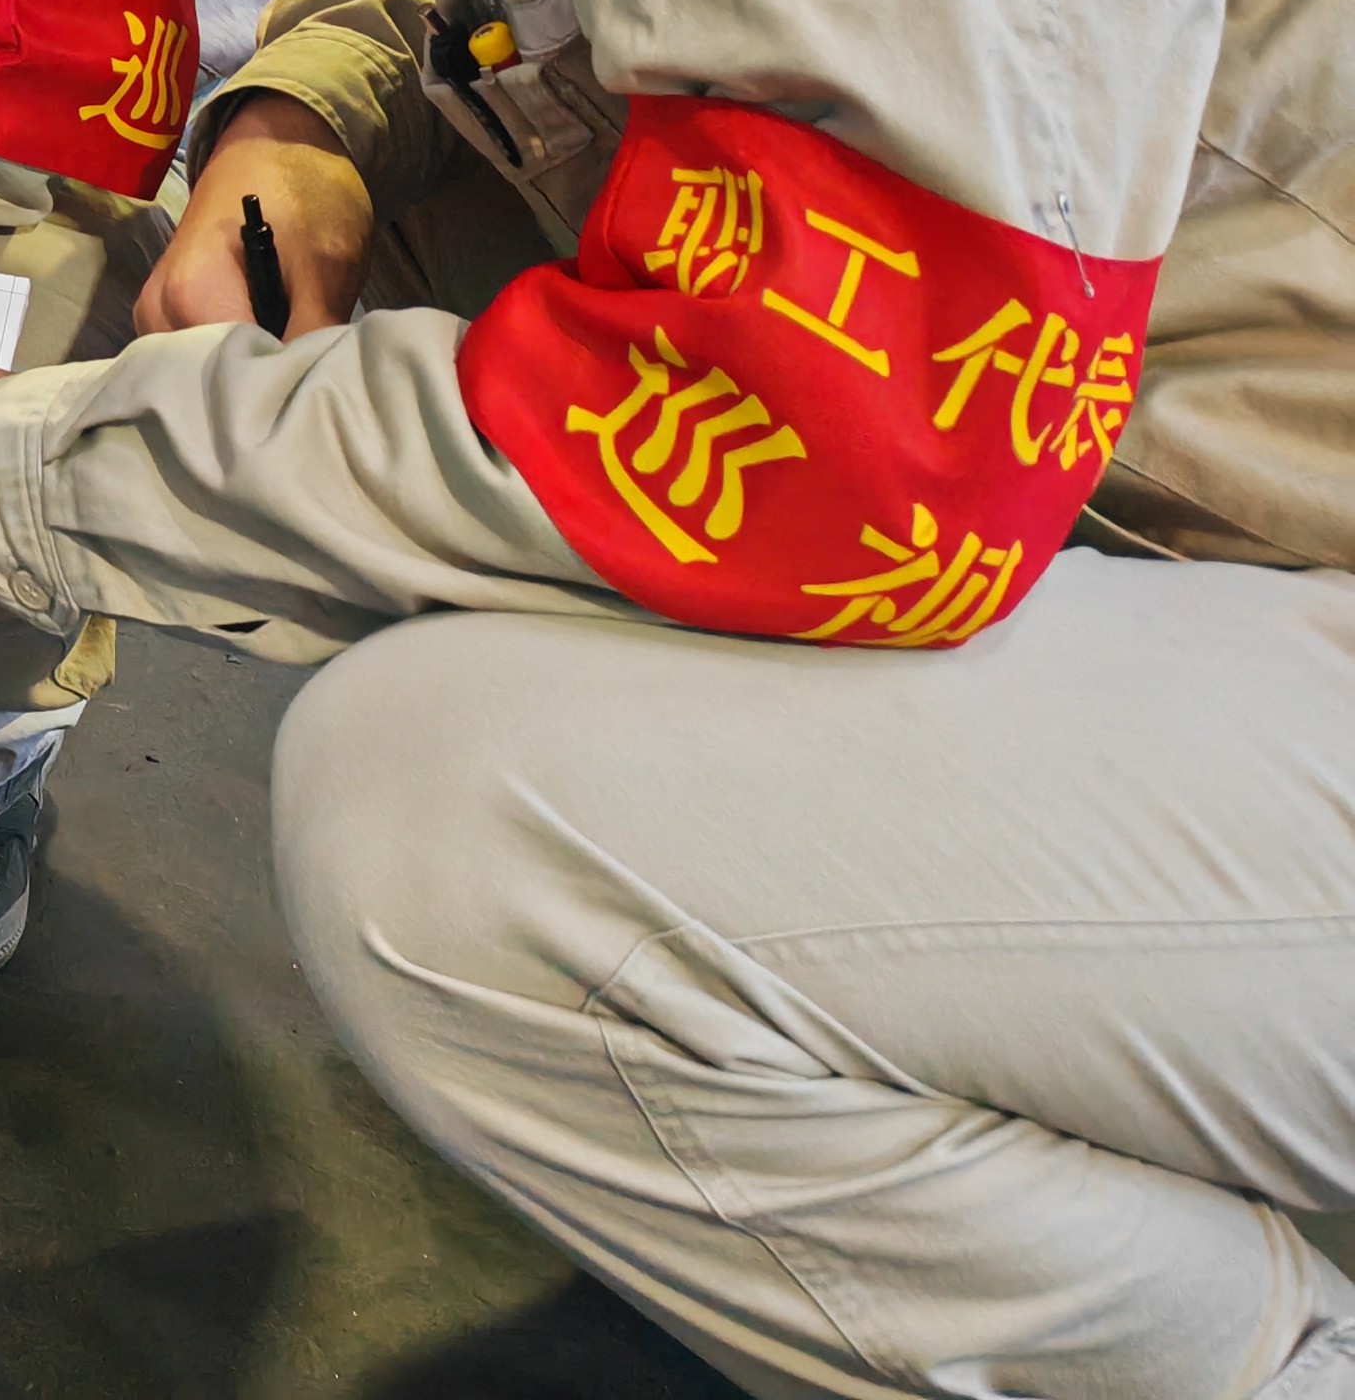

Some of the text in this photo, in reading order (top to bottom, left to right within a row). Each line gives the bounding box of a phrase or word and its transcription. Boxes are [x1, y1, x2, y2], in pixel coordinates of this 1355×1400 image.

[79, 10, 188, 151] 巡
[643, 165, 1135, 471] 职工代表
